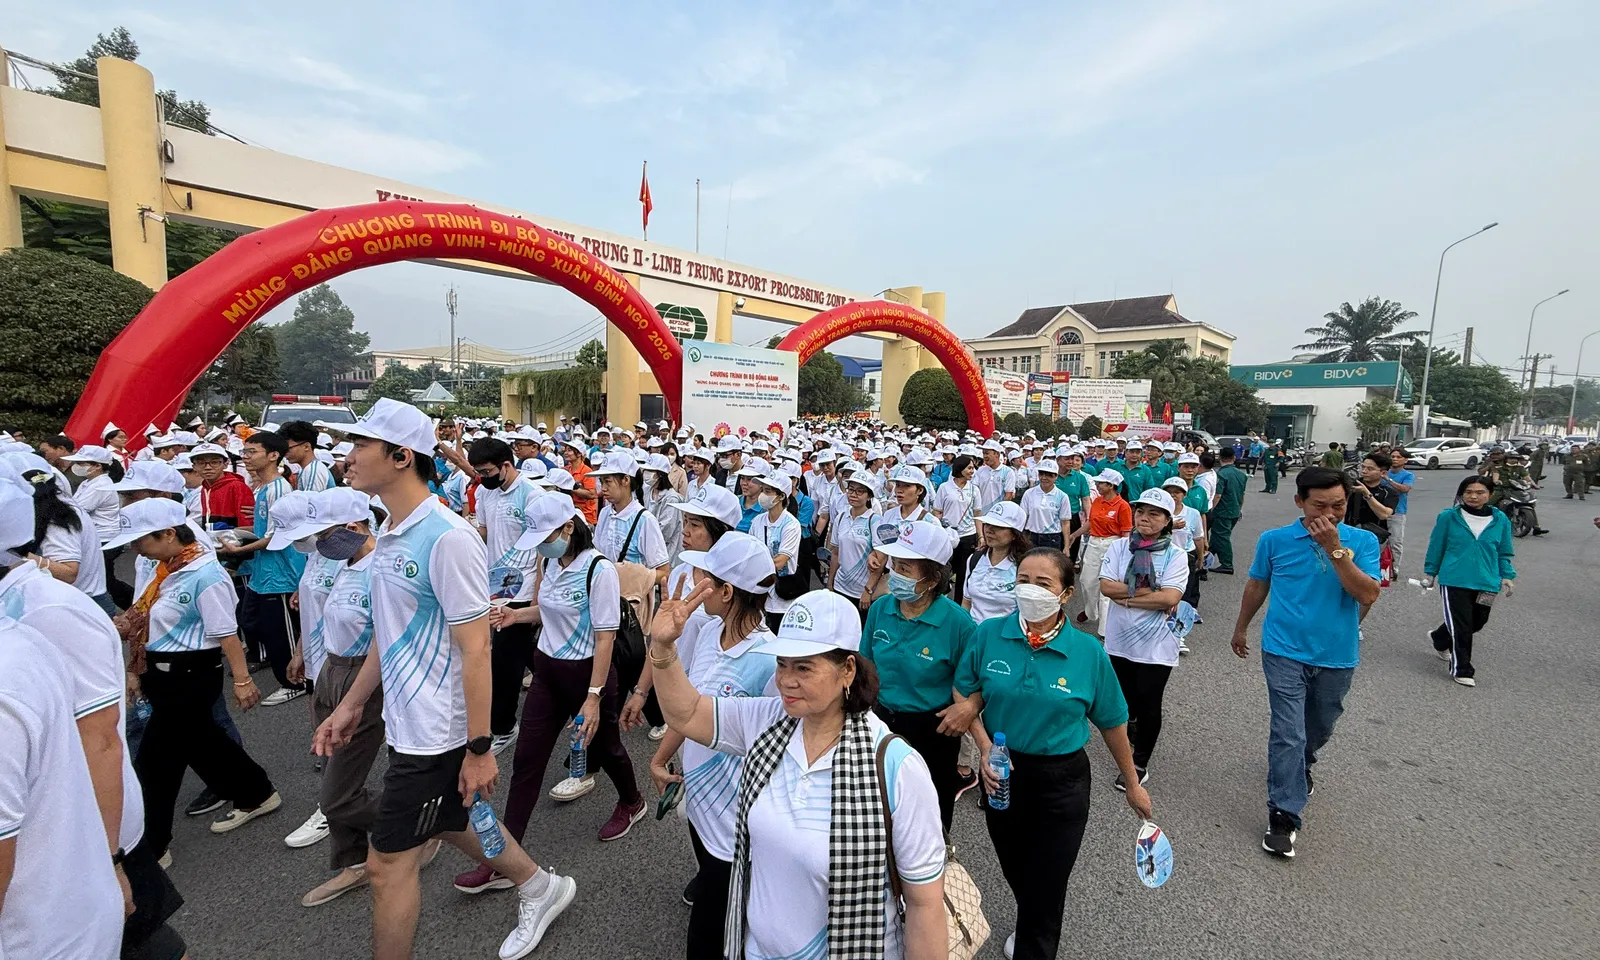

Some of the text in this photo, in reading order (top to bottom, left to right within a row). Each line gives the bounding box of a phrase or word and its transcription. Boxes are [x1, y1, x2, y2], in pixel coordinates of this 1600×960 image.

[319, 212, 415, 245] CHƯƠNG
[422, 211, 483, 231] TRÌNH
[490, 220, 509, 236] ĐI
[516, 225, 540, 247] BỘ
[593, 261, 628, 294] HÀNH
[580, 236, 629, 264] TRUNG
[652, 252, 682, 275] LINH
[686, 260, 724, 283] TRUNG
[727, 270, 768, 293] EXPORT
[771, 280, 825, 305] PROCESSING
[221, 275, 286, 324] MỪNG
[291, 246, 353, 280] ĐẢNG
[363, 233, 433, 255] QUANG
[443, 232, 485, 249] VINH
[498, 238, 546, 263] MỪNG
[551, 256, 592, 284] XUÂN
[593, 279, 624, 306] BÍNH
[623, 303, 649, 331] NGỌ
[647, 330, 673, 361] 2026
[1254, 371, 1282, 382] BIDV
[1324, 368, 1356, 380] BIDV
[980, 407, 990, 426] 2026
